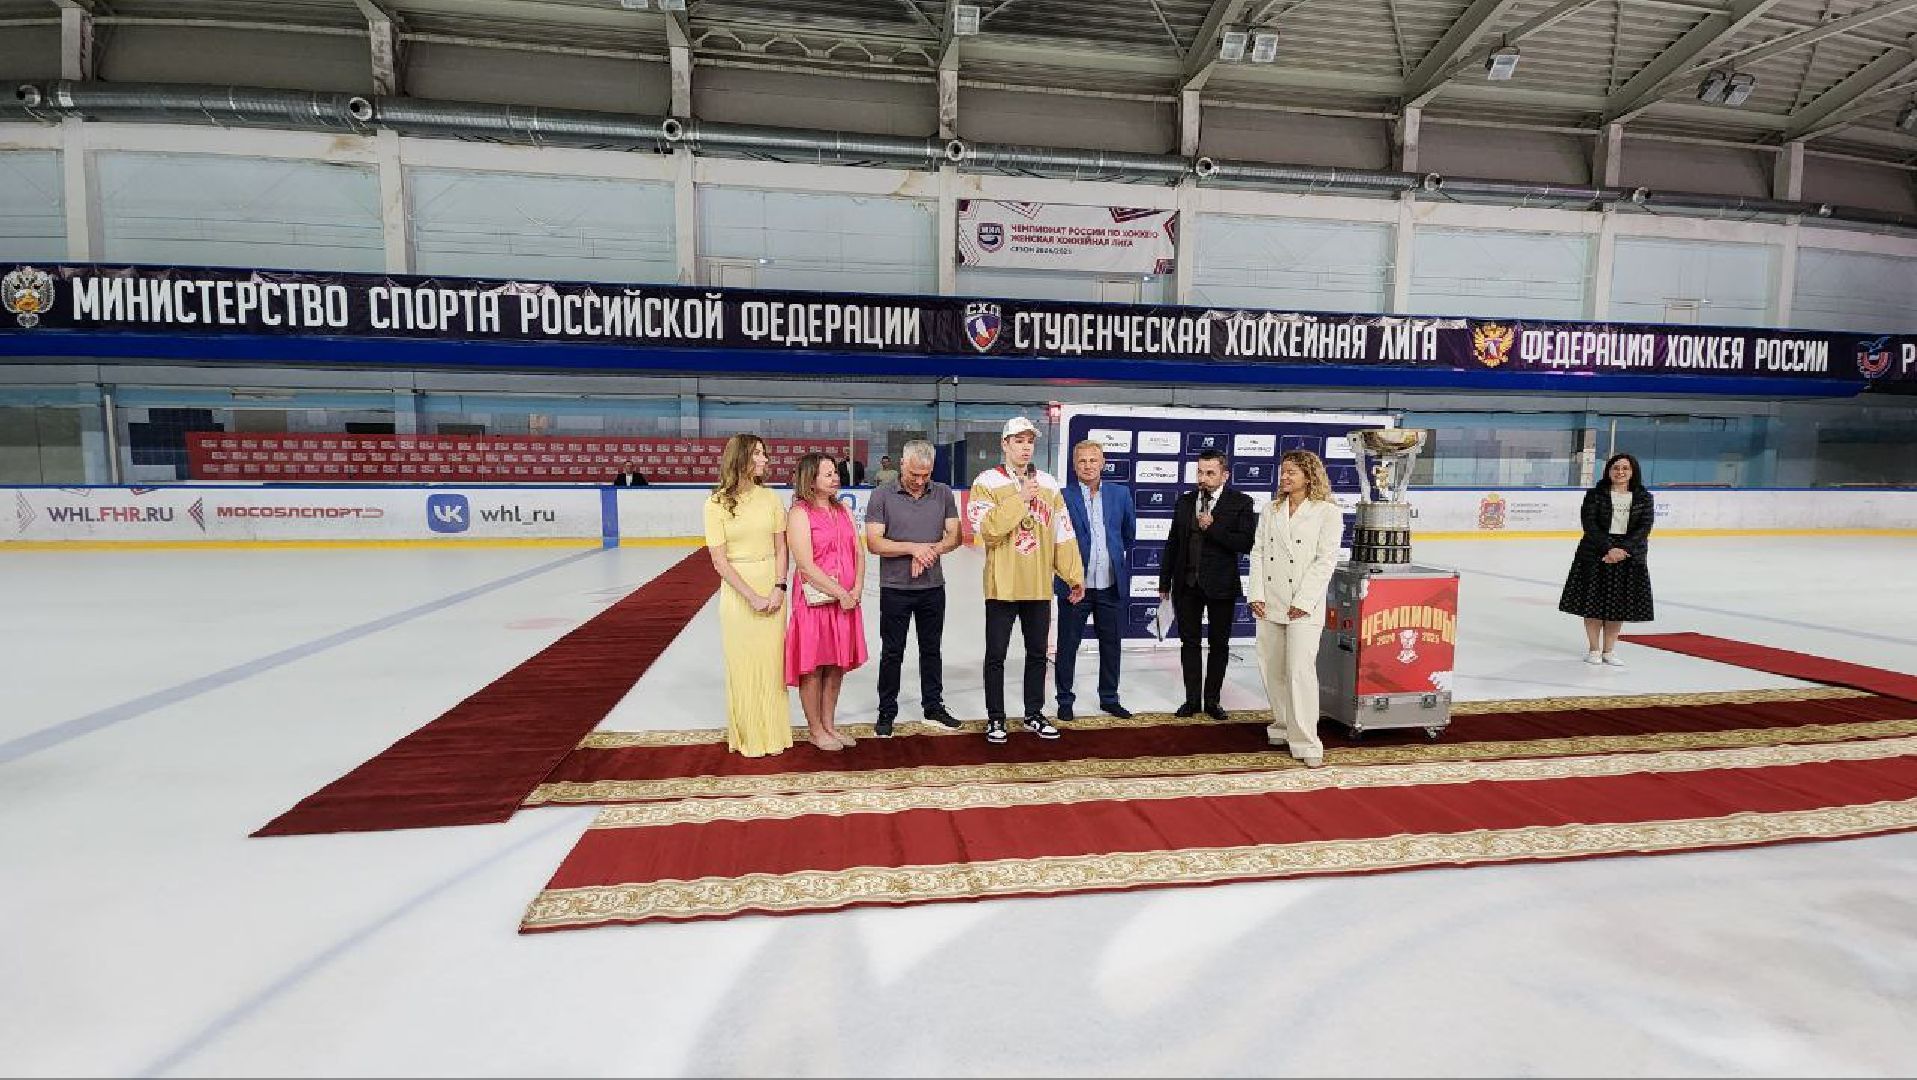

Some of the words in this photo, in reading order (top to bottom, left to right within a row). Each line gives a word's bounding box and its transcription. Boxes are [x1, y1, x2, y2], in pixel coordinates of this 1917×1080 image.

[1011, 224, 1067, 236] ЧЕМПИОНАТ
[1068, 226, 1106, 237] РОССИИ
[1107, 227, 1121, 237] ПО
[1011, 234, 1055, 244] ЖЕНСКАЯ
[1056, 235, 1110, 246] ХОККЕЙНАЯ
[1111, 238, 1133, 248] ЛИГА
[72, 276, 349, 328] МИНИСТЕРСТВО
[369, 286, 500, 333] СПОРТА
[520, 288, 724, 341] РОССИЙСКОЙ
[741, 300, 920, 349] ФЕДЕРАЦИИ
[1013, 311, 1211, 355] СТУДЕНЧЕСКАЯ
[1225, 315, 1367, 360] ХОККЕЙНАЯ
[1379, 321, 1437, 361] ЛИГА
[1520, 332, 1655, 370] ФЕДЕРАЦИЯ
[1665, 335, 1744, 370] ХОККЕЯ
[1754, 338, 1829, 373] РОССИИ
[47, 505, 174, 522] WHL.FHR.RU
[480, 505, 555, 524] whl_ru
[1361, 605, 1456, 646] ЧЕМПИОНЫ
